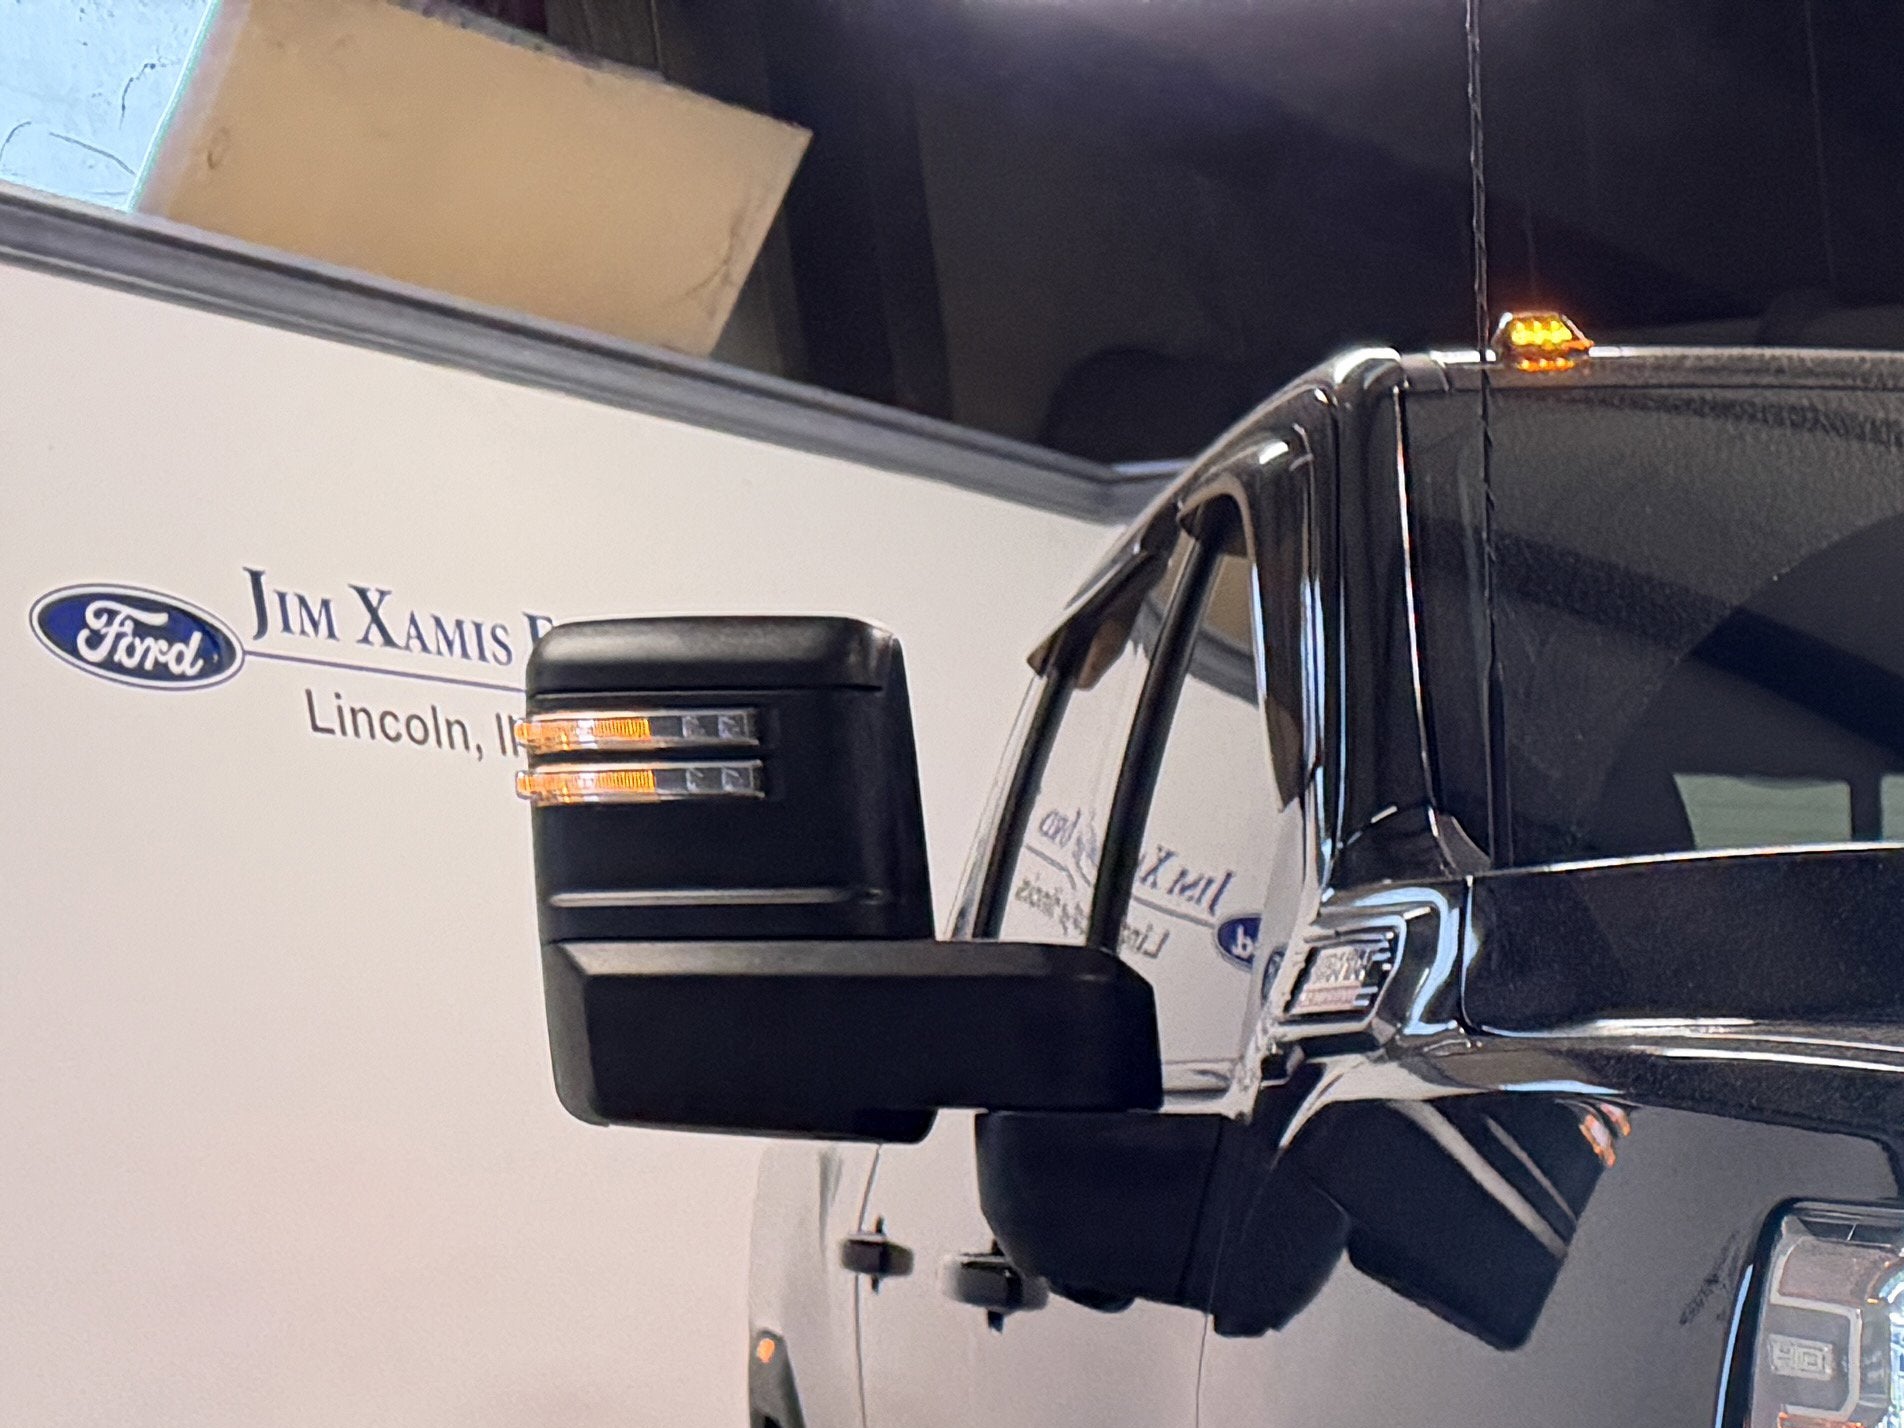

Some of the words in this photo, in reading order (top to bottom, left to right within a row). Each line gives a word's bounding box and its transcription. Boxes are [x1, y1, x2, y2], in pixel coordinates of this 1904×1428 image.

[76, 599, 204, 676] Ford
[243, 566, 340, 641] JIM
[348, 583, 513, 666] XAMIS
[305, 688, 484, 762] Lincoln,
